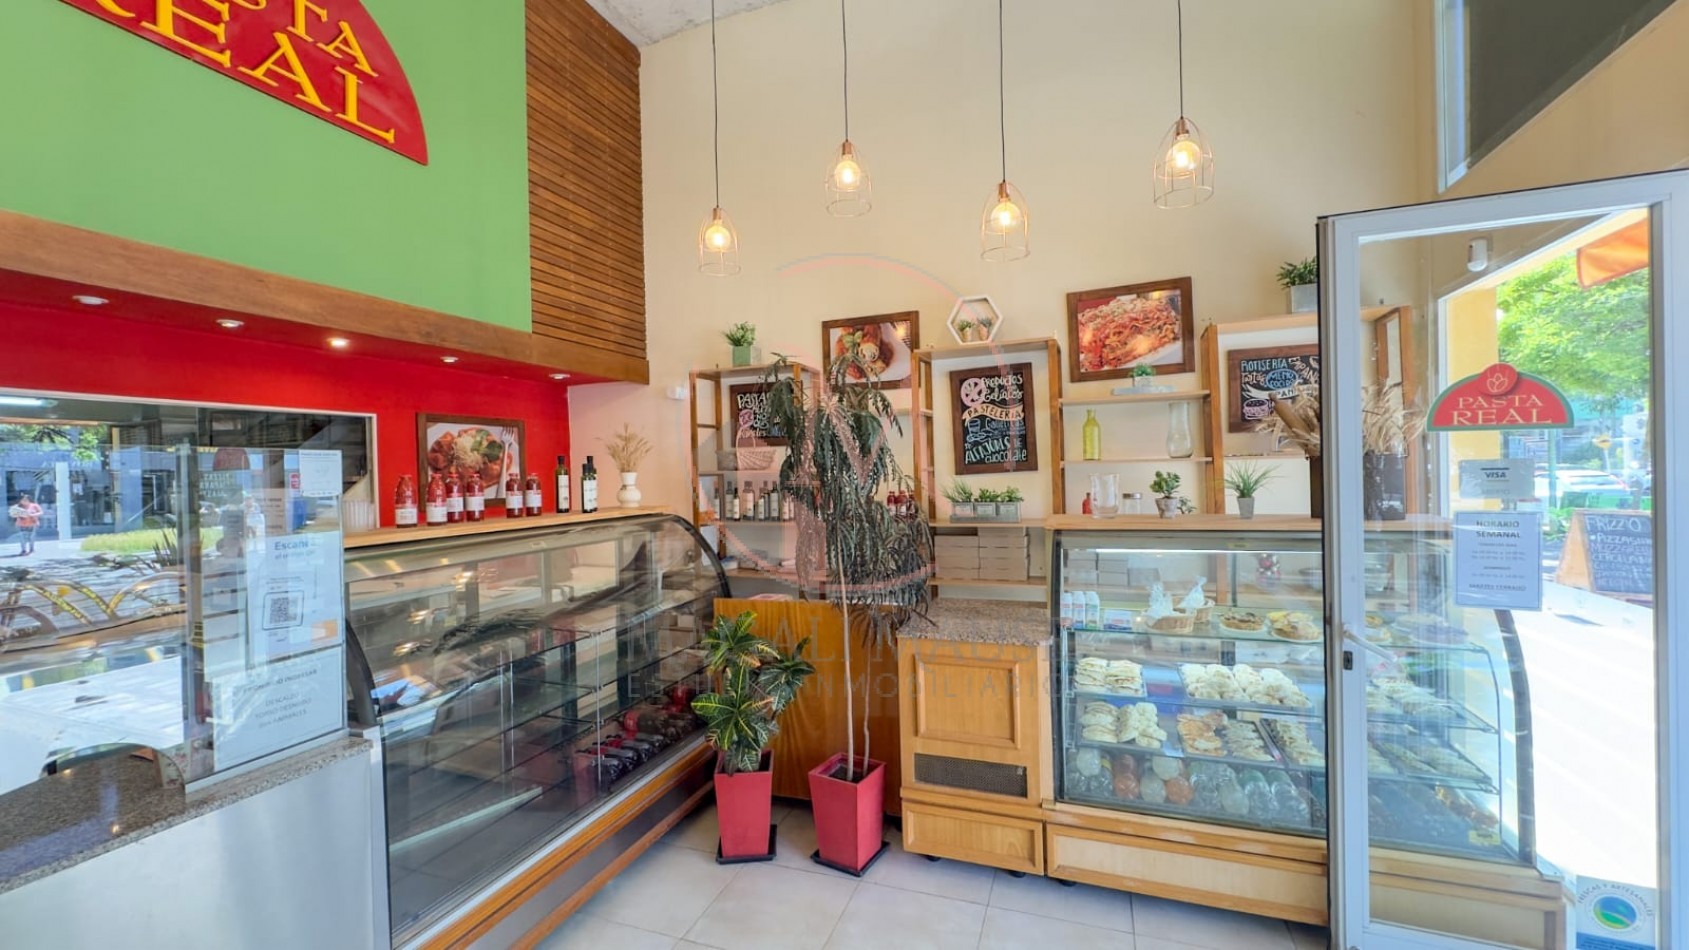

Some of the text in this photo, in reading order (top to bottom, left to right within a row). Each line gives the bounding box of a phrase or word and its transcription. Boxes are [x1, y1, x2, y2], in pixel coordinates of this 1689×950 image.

[95, 0, 395, 143] EAL
[1458, 394, 1544, 409] PASTA
[1452, 408, 1552, 426] REAL
[1476, 520, 1520, 528] HORARIO
[1475, 530, 1521, 538] SEMANAL
